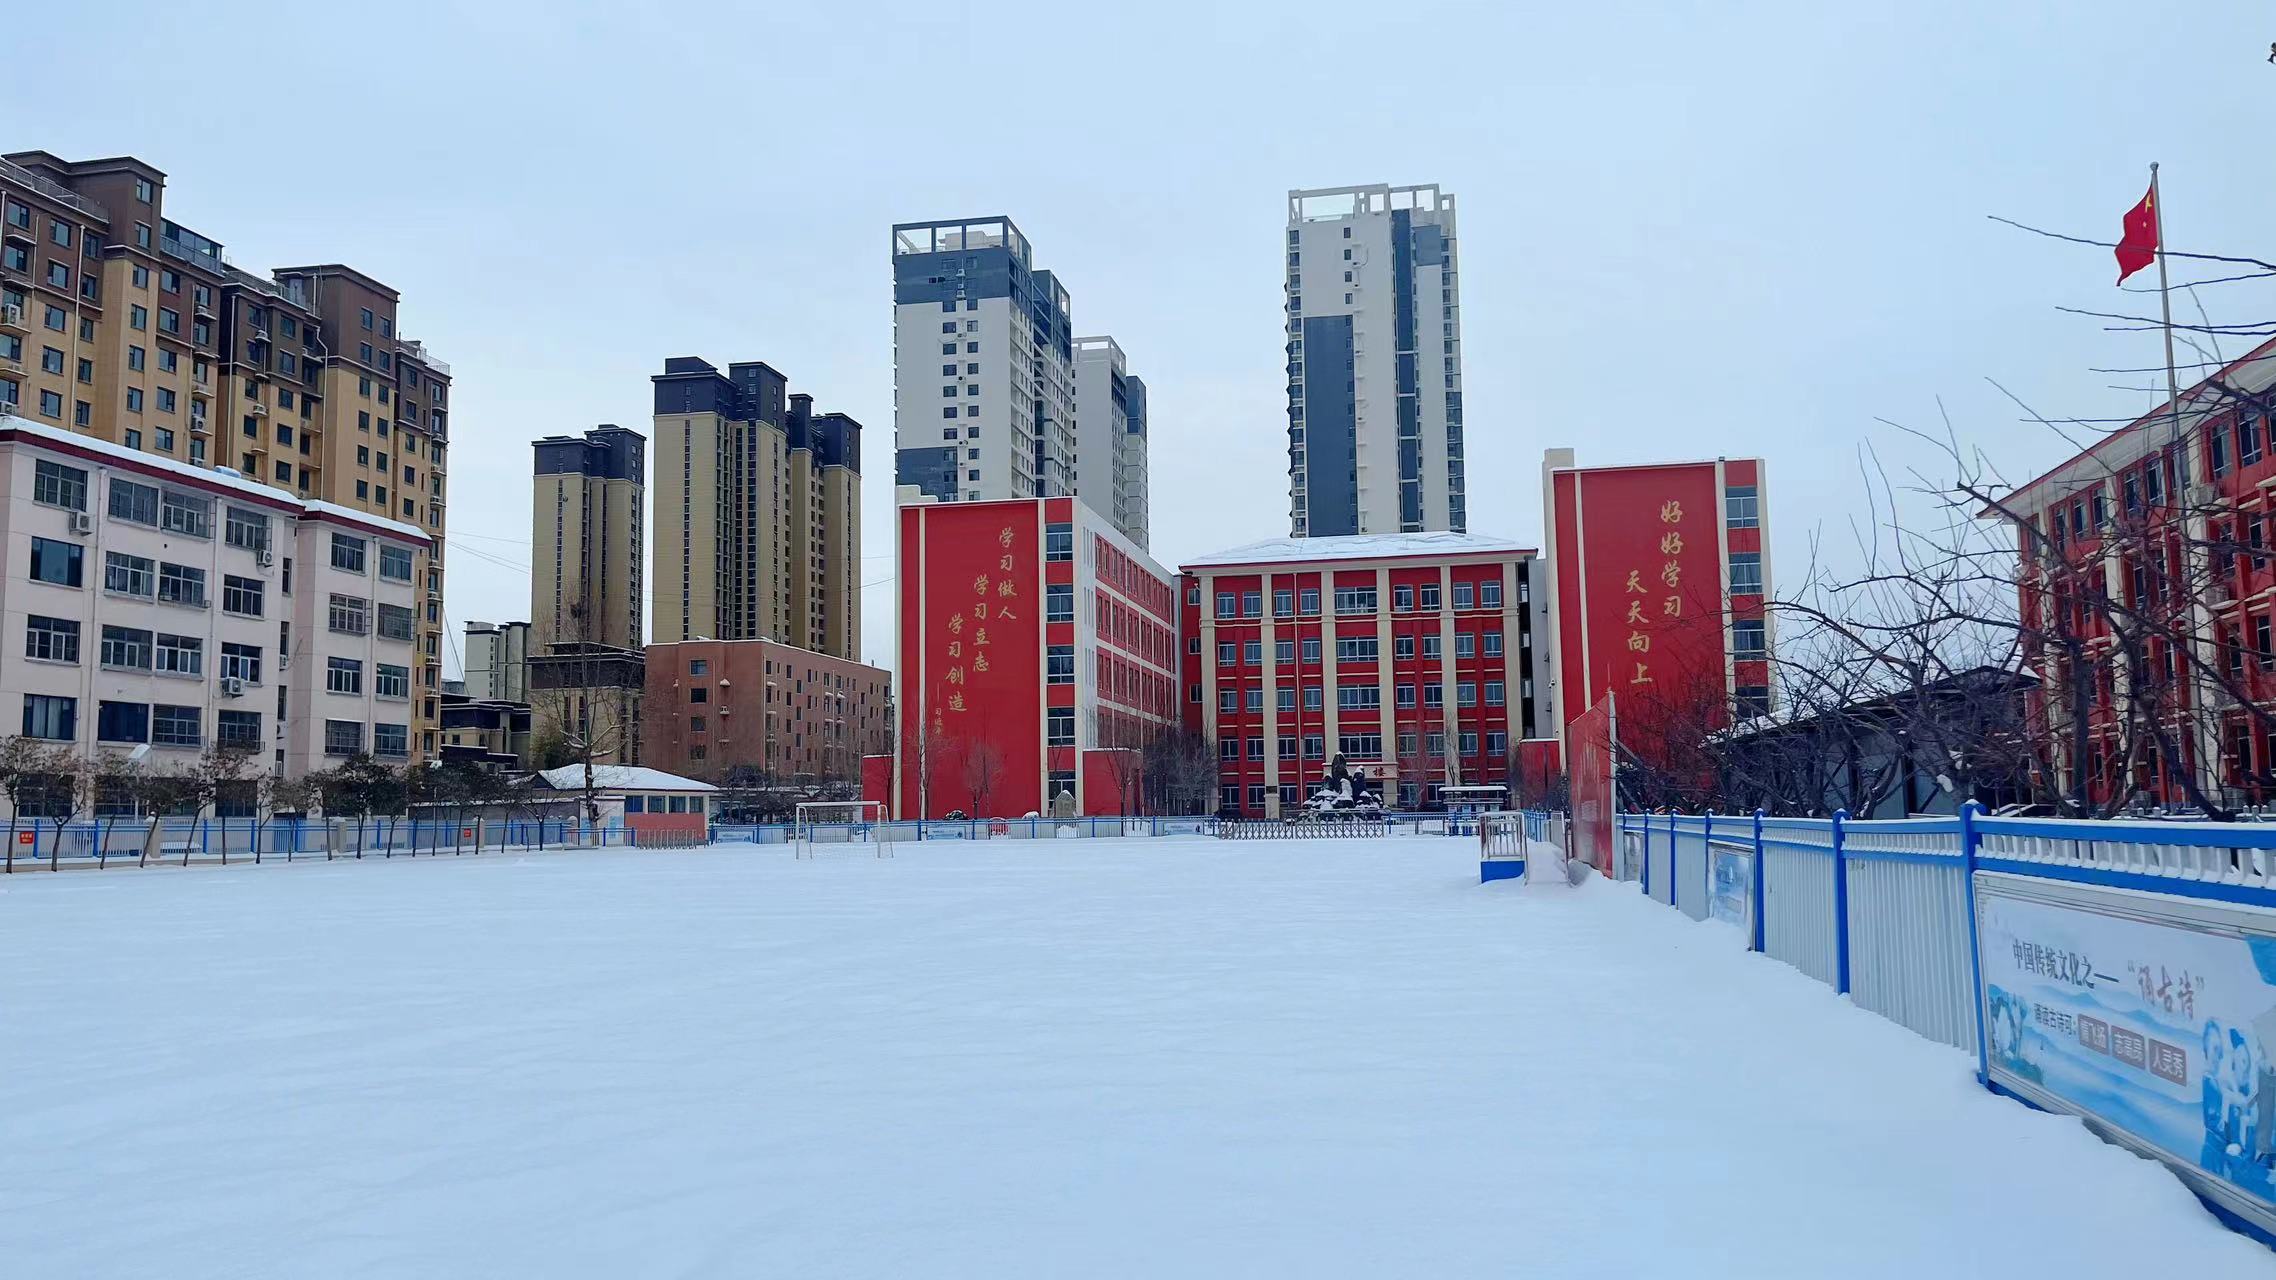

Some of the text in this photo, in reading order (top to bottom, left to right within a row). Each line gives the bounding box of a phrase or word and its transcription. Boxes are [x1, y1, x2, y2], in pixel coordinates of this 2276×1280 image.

[997, 526, 1017, 620] 学习做人
[1660, 500, 1684, 618] 好好学习
[945, 612, 968, 712] 学习创造
[973, 574, 991, 673] 学习立志
[1625, 569, 1654, 685] 天天向上
